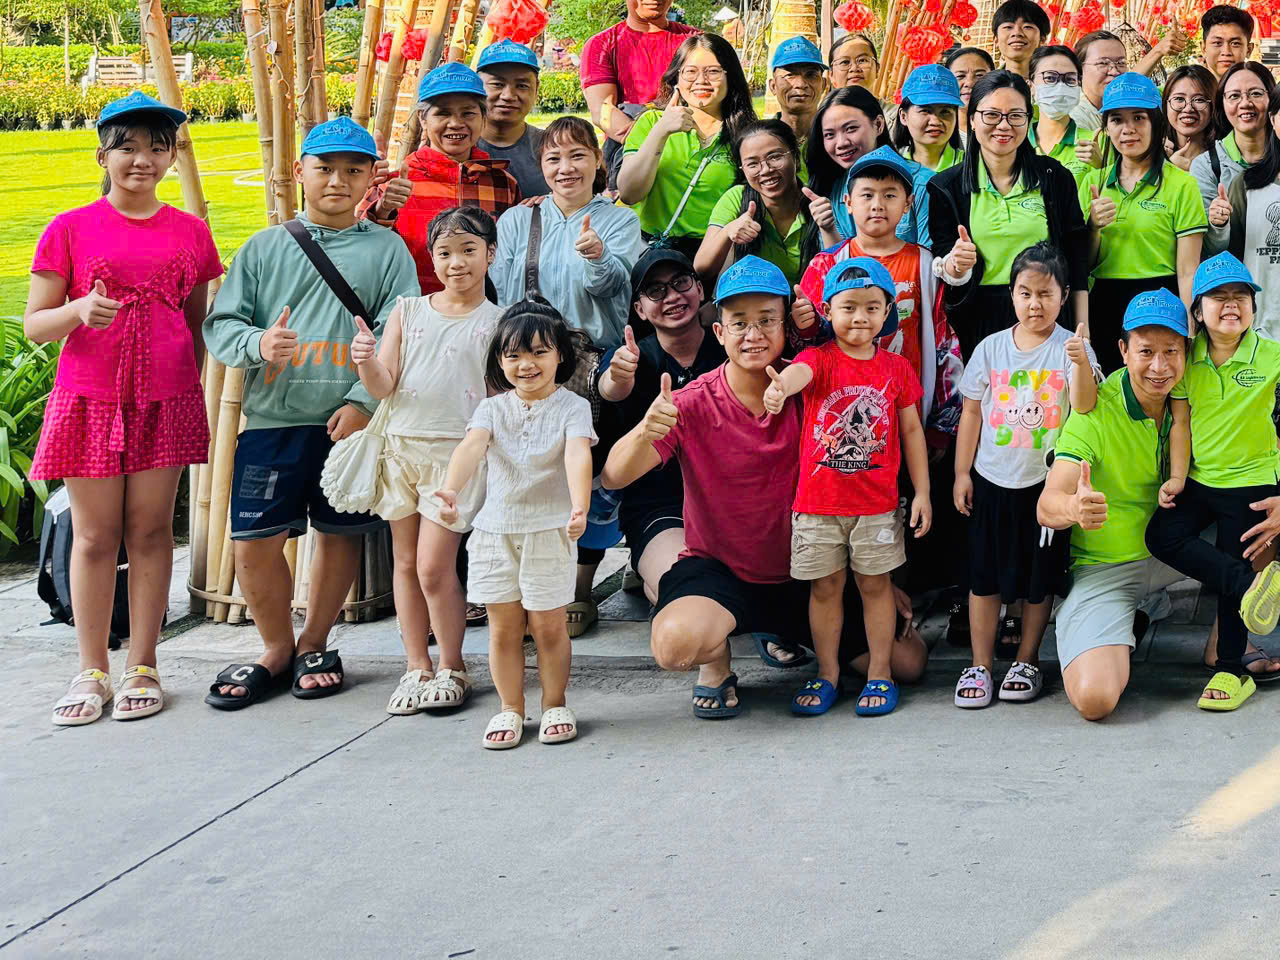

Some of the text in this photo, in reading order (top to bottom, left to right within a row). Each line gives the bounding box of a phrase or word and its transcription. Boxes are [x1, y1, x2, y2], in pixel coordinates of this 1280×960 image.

[991, 368, 1065, 391] HAVE
[995, 425, 1049, 449] DAY
[831, 460, 869, 470] THE KING
[231, 666, 254, 681] C
